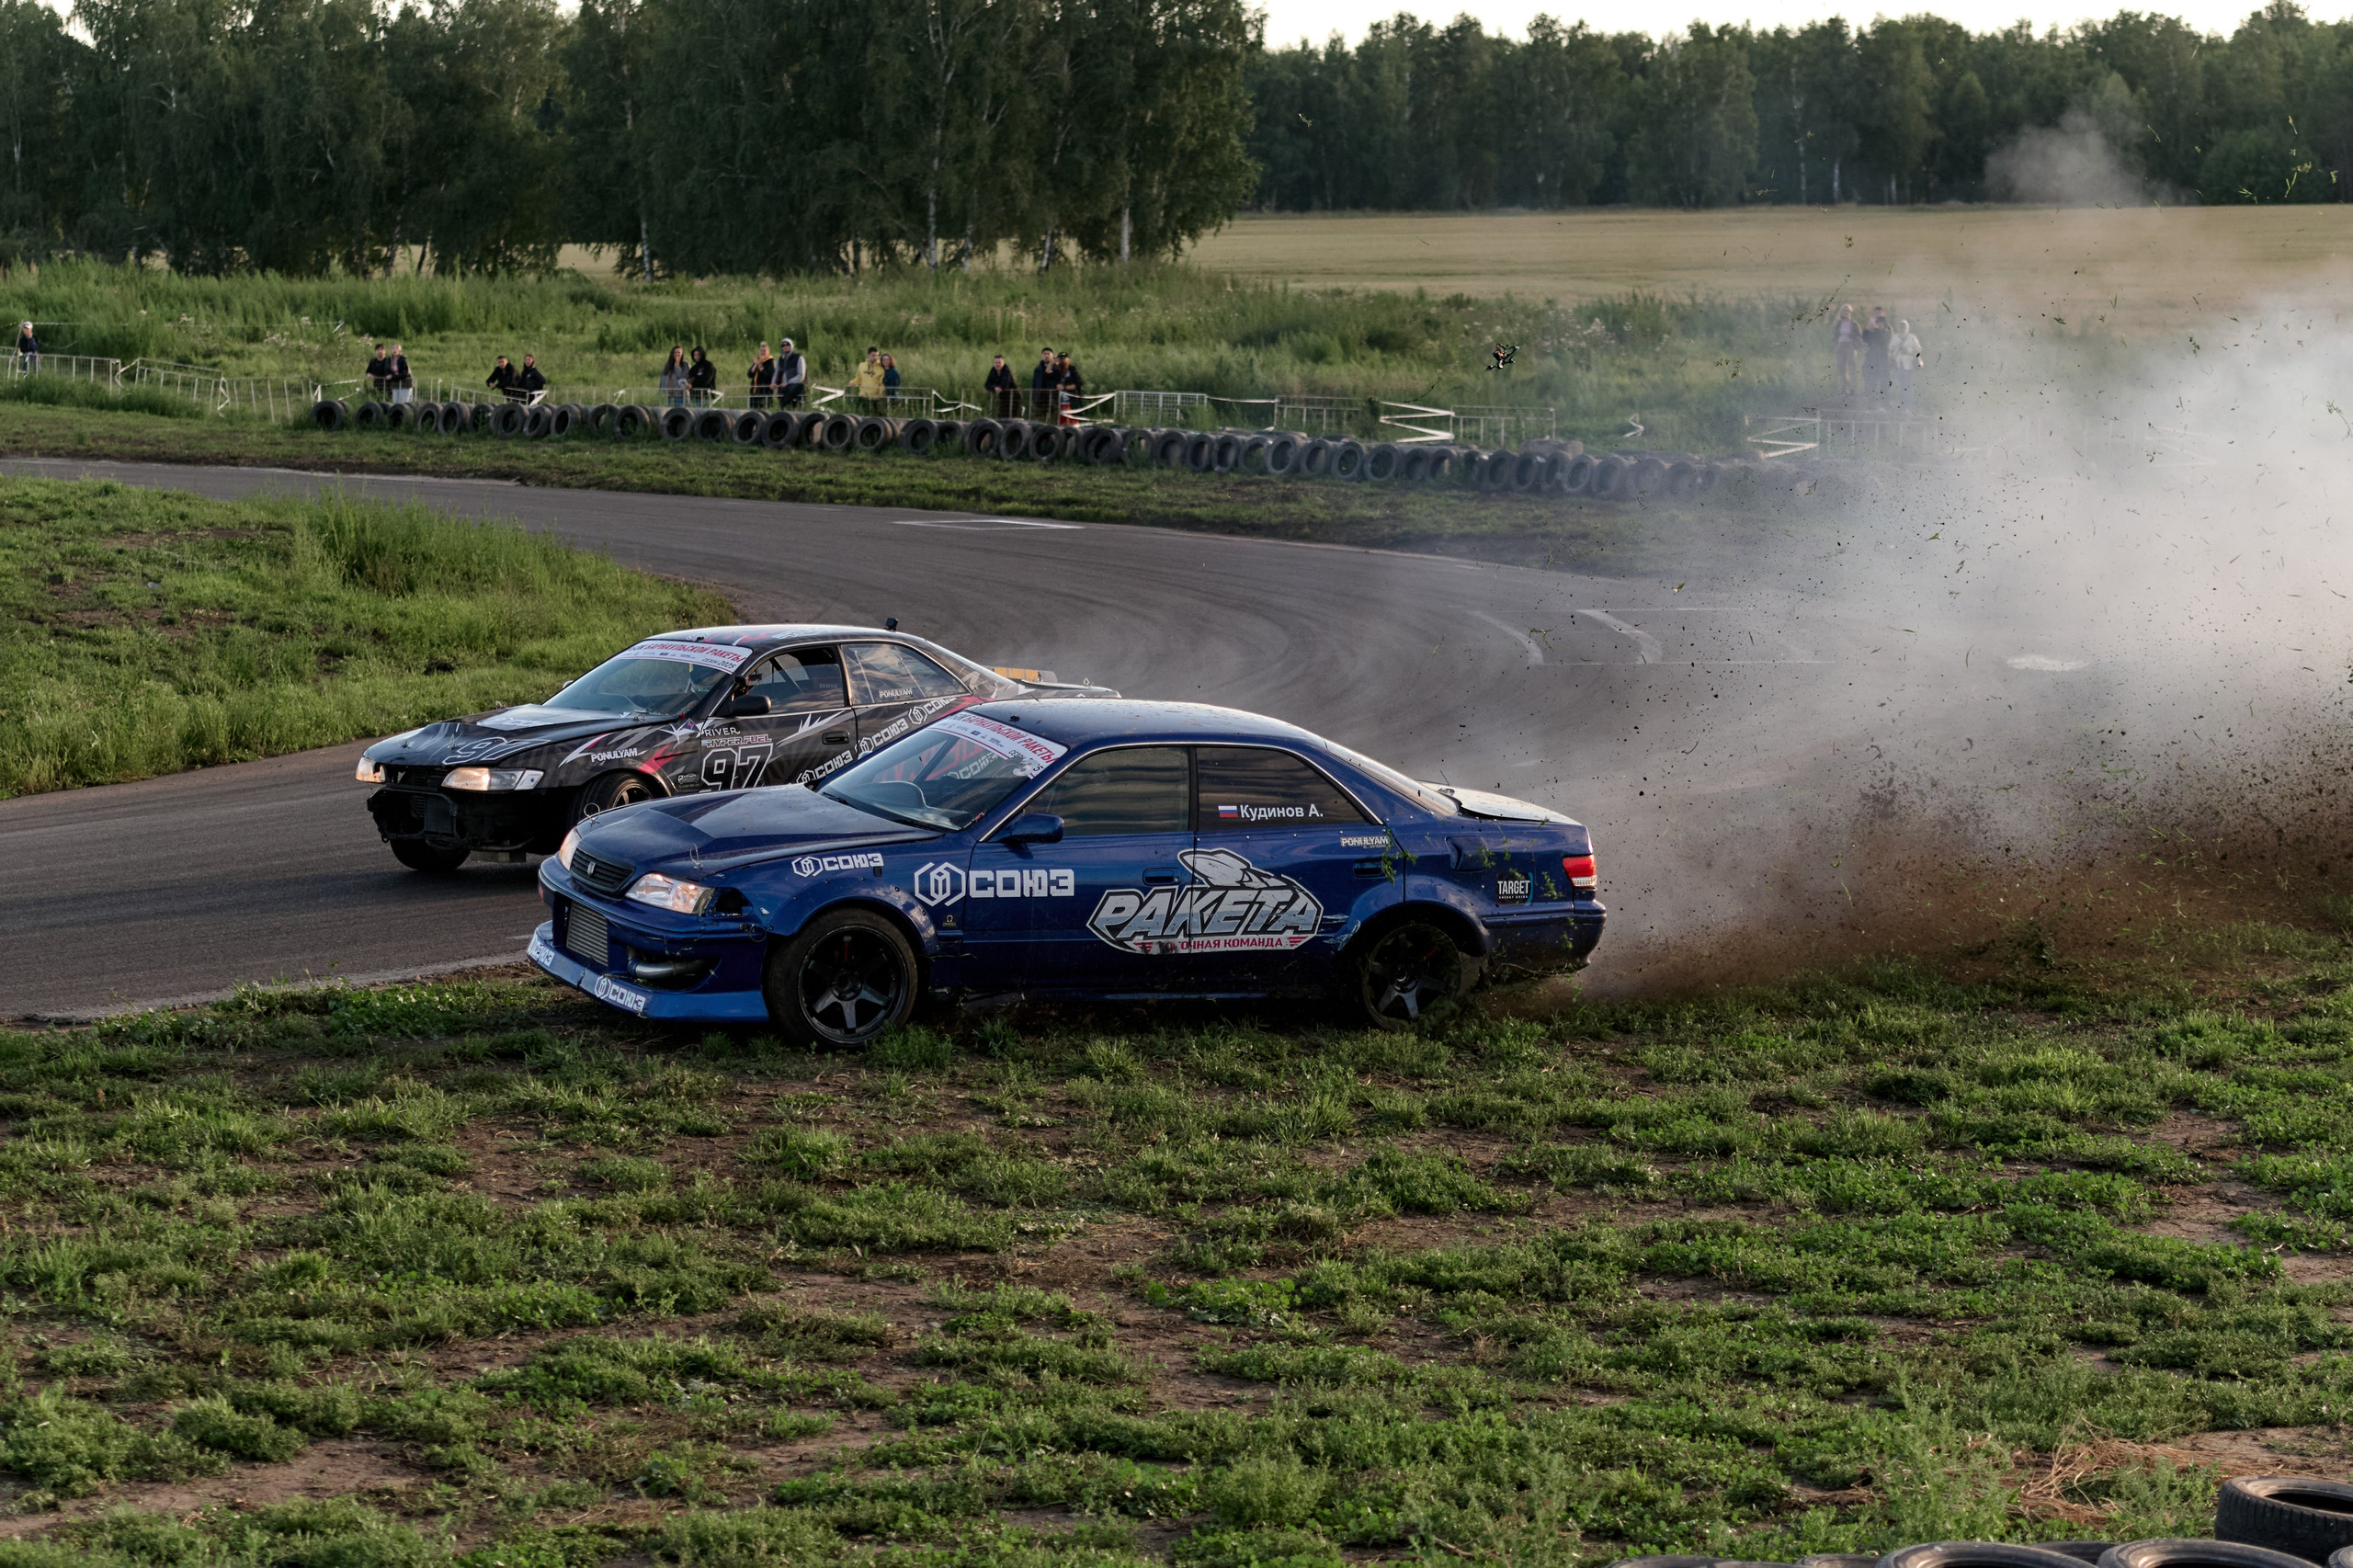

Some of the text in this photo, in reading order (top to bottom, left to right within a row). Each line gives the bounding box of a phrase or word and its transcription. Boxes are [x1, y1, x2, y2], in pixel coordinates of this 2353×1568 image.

[707, 646, 746, 662] РАКЕТЫ
[717, 661, 736, 669] 2025
[878, 688, 913, 699] PONULYAM
[704, 727, 740, 736] RIVER
[872, 719, 909, 747] СОЮЗ
[442, 736, 551, 765] 97
[591, 748, 638, 762] PONULYAM
[1018, 738, 1060, 764] РАКЕТЫ
[701, 743, 774, 791] 97
[814, 750, 853, 779] СОЮЗ
[1240, 804, 1324, 821] Кудинов А.
[1341, 836, 1389, 846] PONULYAM
[823, 853, 884, 870] СОЮЗ
[969, 869, 1074, 898] СОЮЗ
[1497, 881, 1530, 894] TARGET
[1093, 888, 1319, 937] РАКЕТА
[1223, 937, 1283, 949] КОМАНДА
[608, 984, 646, 1012] СОЮЗ
